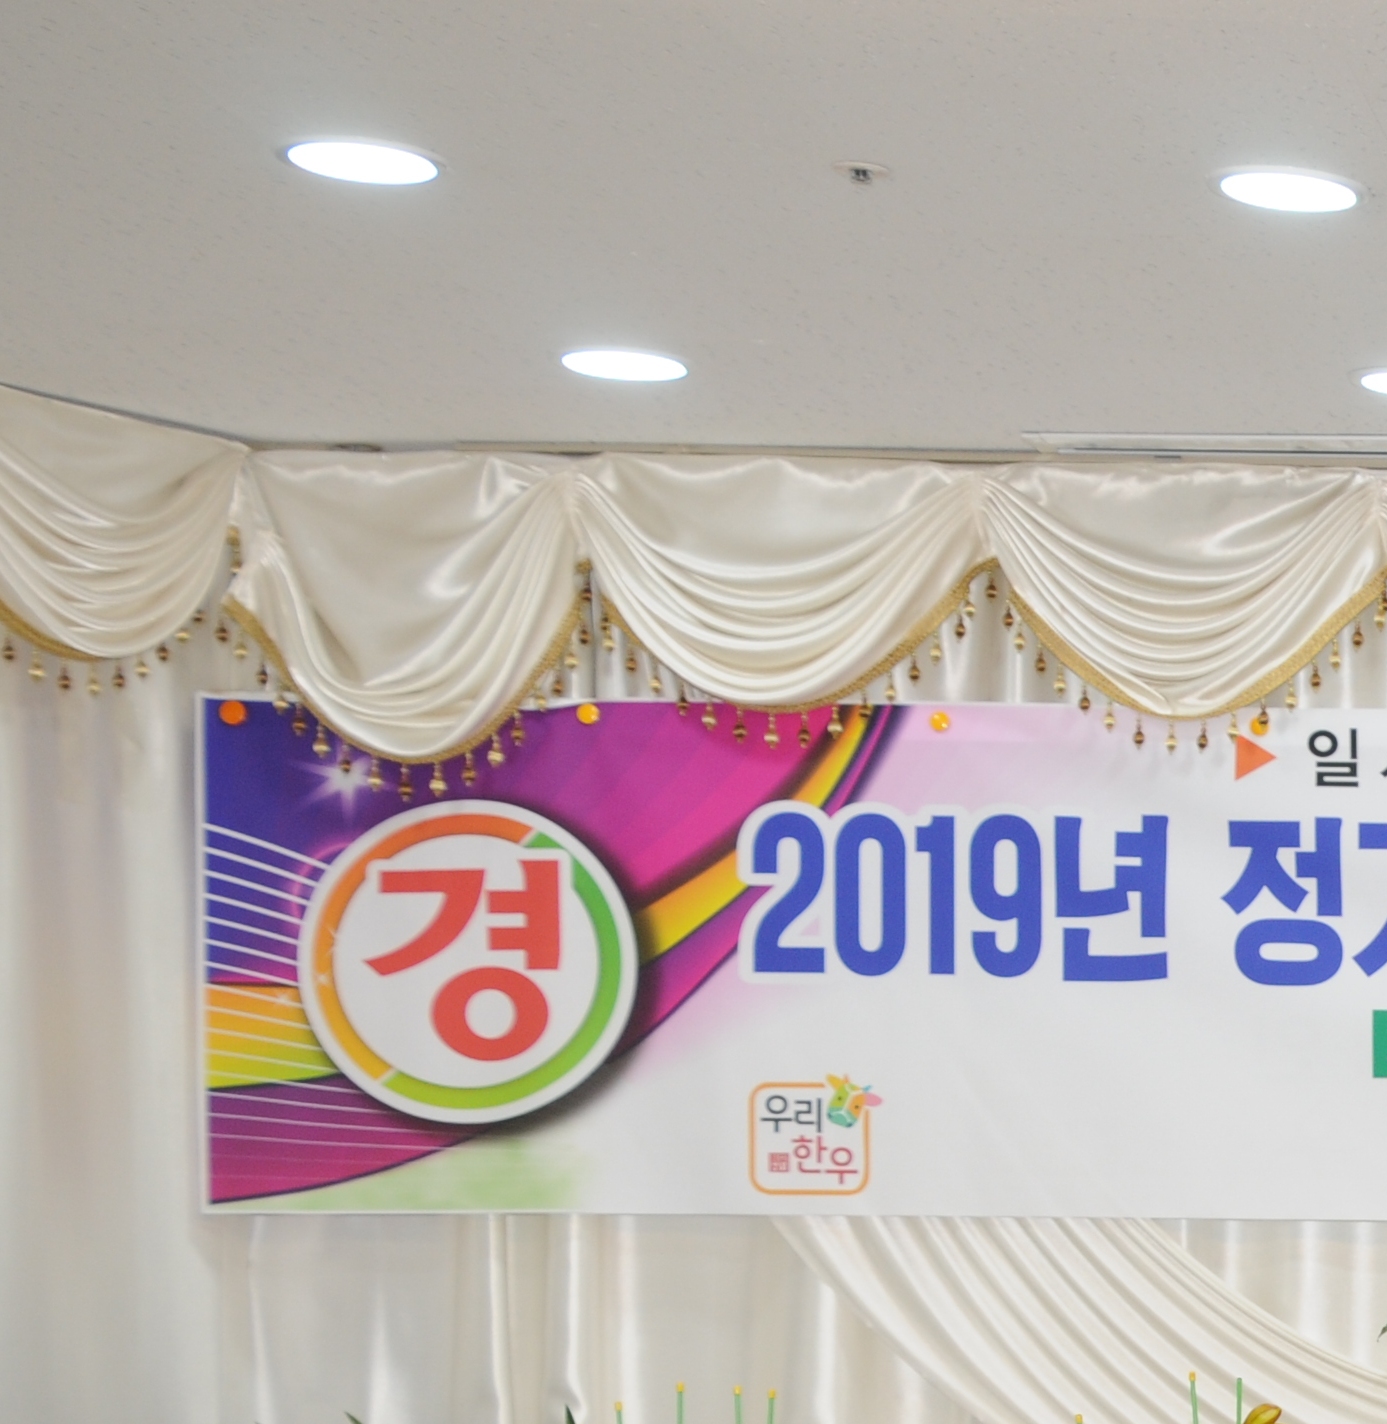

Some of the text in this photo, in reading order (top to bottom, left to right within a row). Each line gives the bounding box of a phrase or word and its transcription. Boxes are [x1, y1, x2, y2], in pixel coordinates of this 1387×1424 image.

[751, 811, 1170, 983] 2019년
[363, 858, 563, 1062] 경
[760, 1094, 823, 1133] 우리
[791, 1135, 858, 1185] 한우
